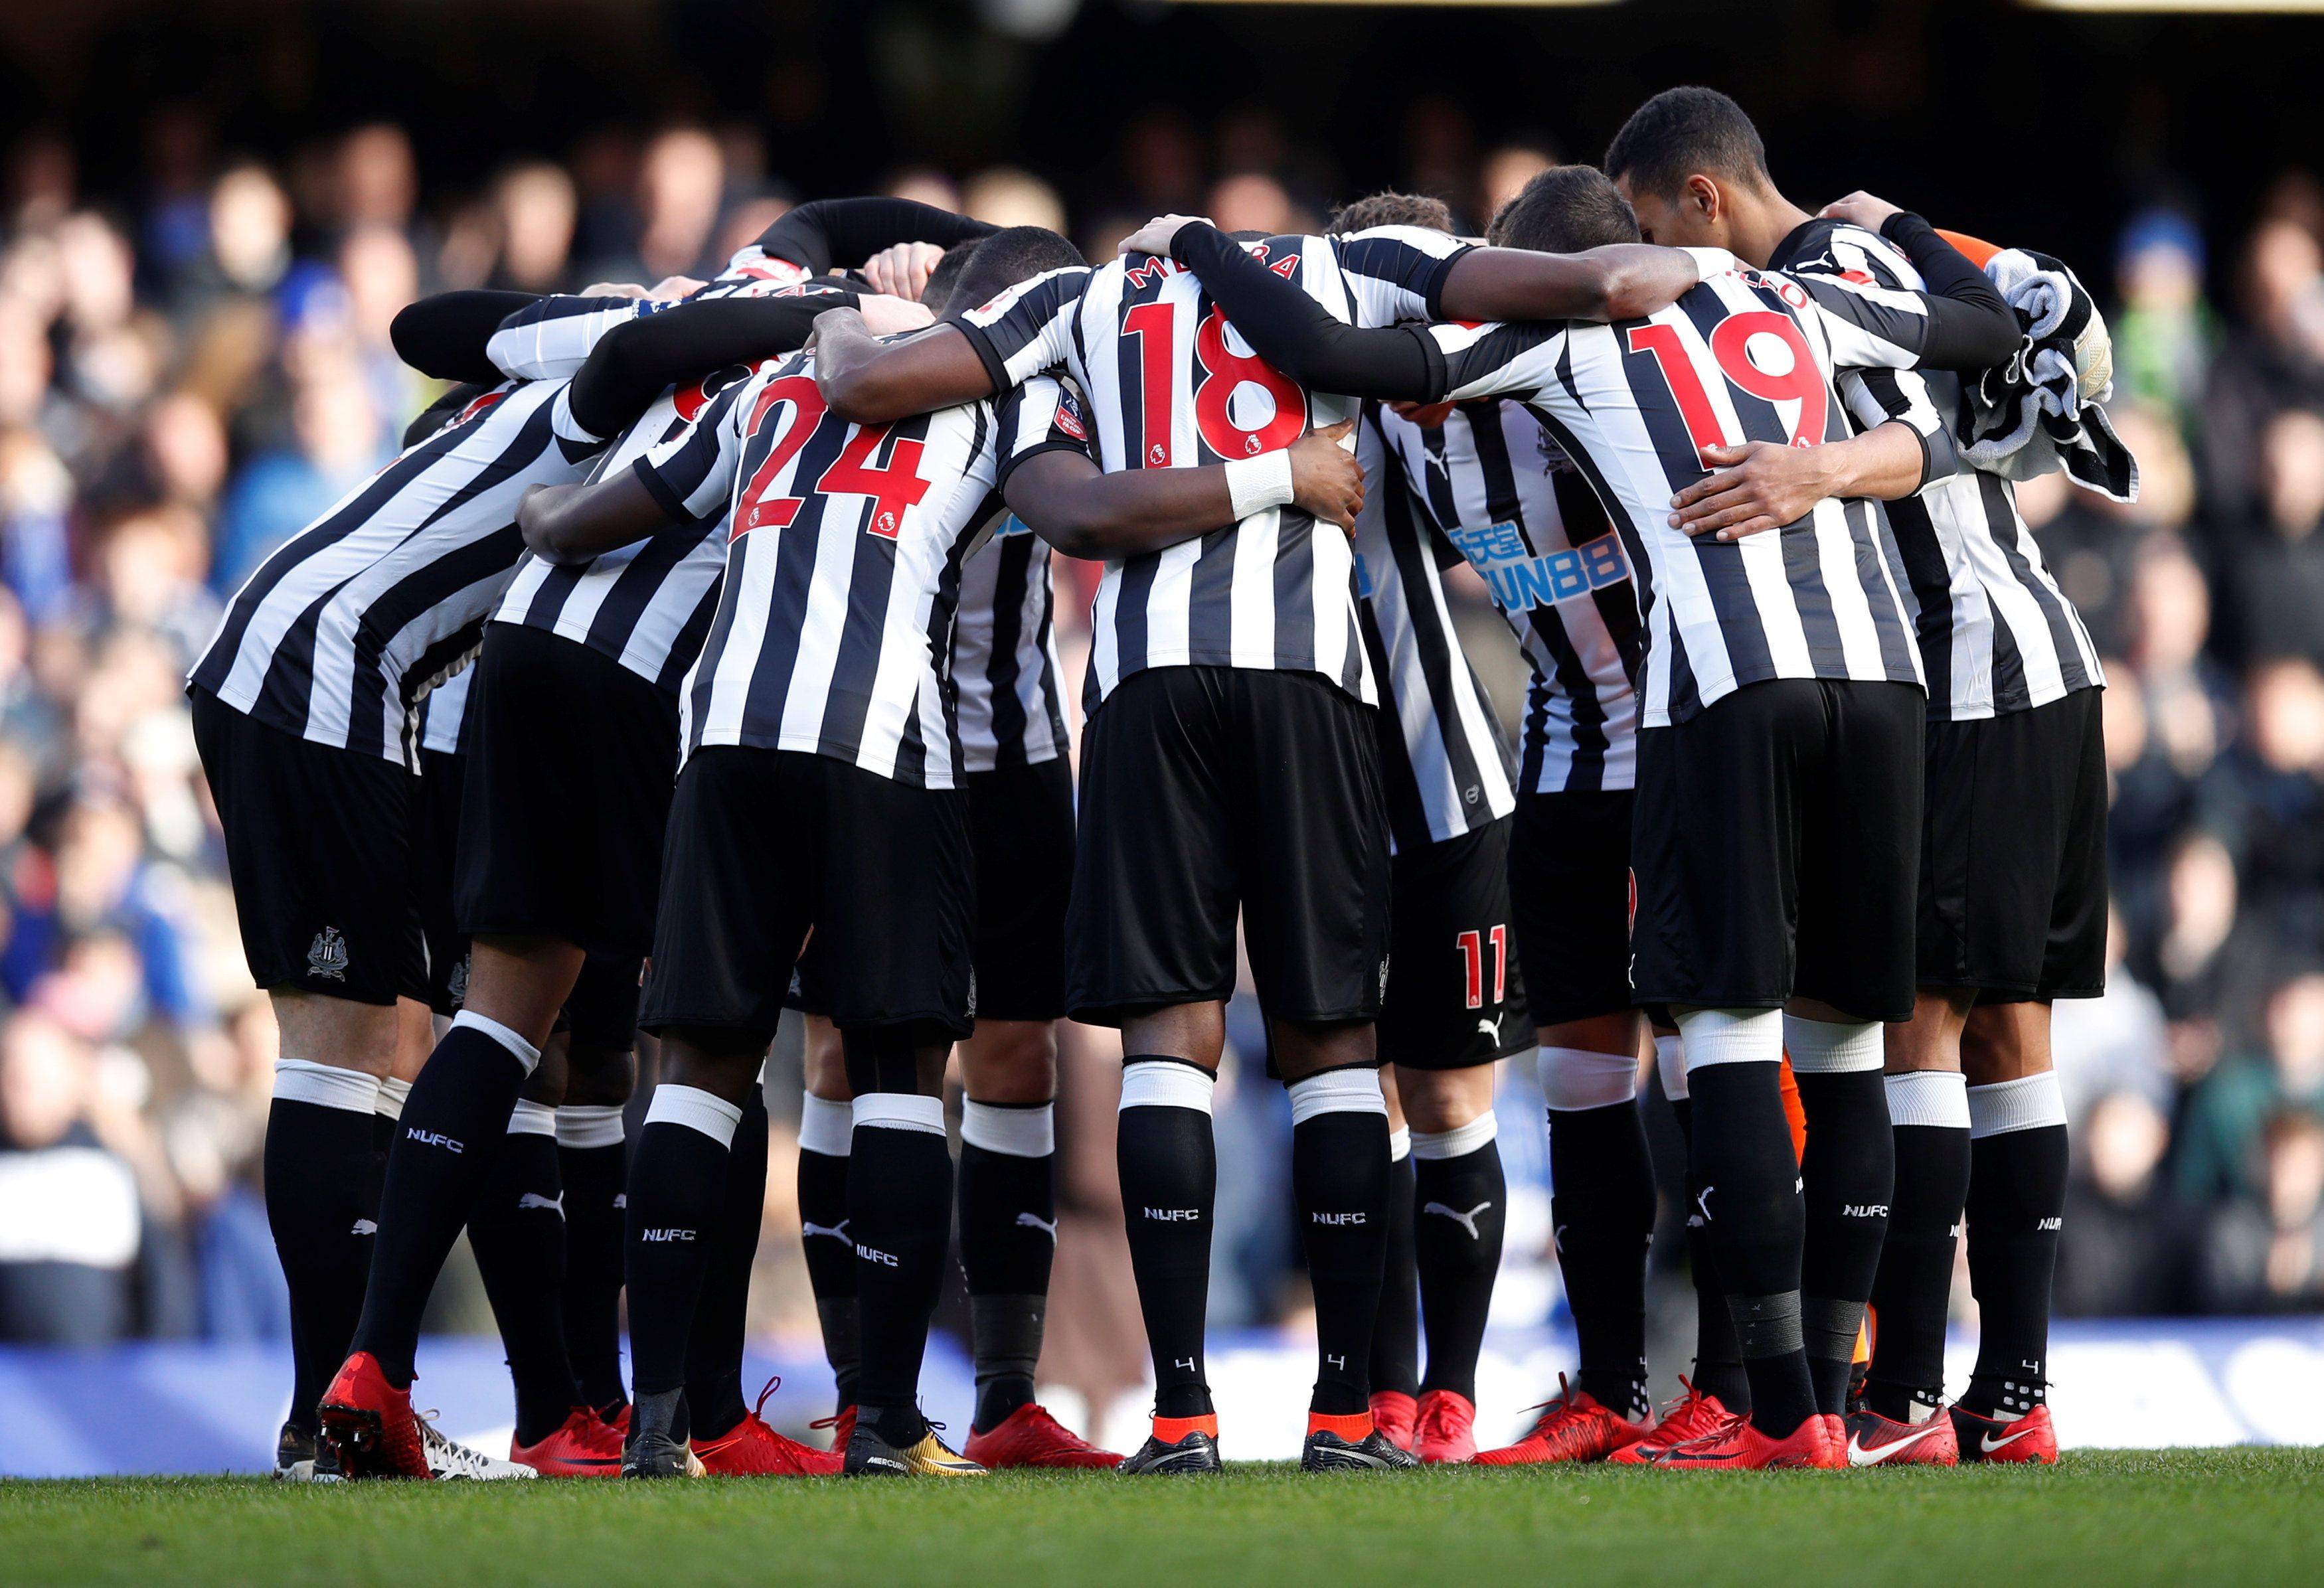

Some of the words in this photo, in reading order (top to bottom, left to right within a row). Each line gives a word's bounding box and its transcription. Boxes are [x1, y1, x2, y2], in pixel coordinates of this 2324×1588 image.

[1121, 302, 1307, 469] 18
[1627, 310, 1827, 472] 19
[728, 374, 931, 544] 24
[1456, 923, 1506, 1009] 11
[406, 1127, 463, 1153] NUFC
[1144, 1206, 1199, 1222] NUFC
[1312, 1212, 1367, 1226] NUFC
[1842, 1204, 1888, 1218] NUFC
[642, 1228, 696, 1241] NUFC
[857, 1243, 898, 1267] NUFC
